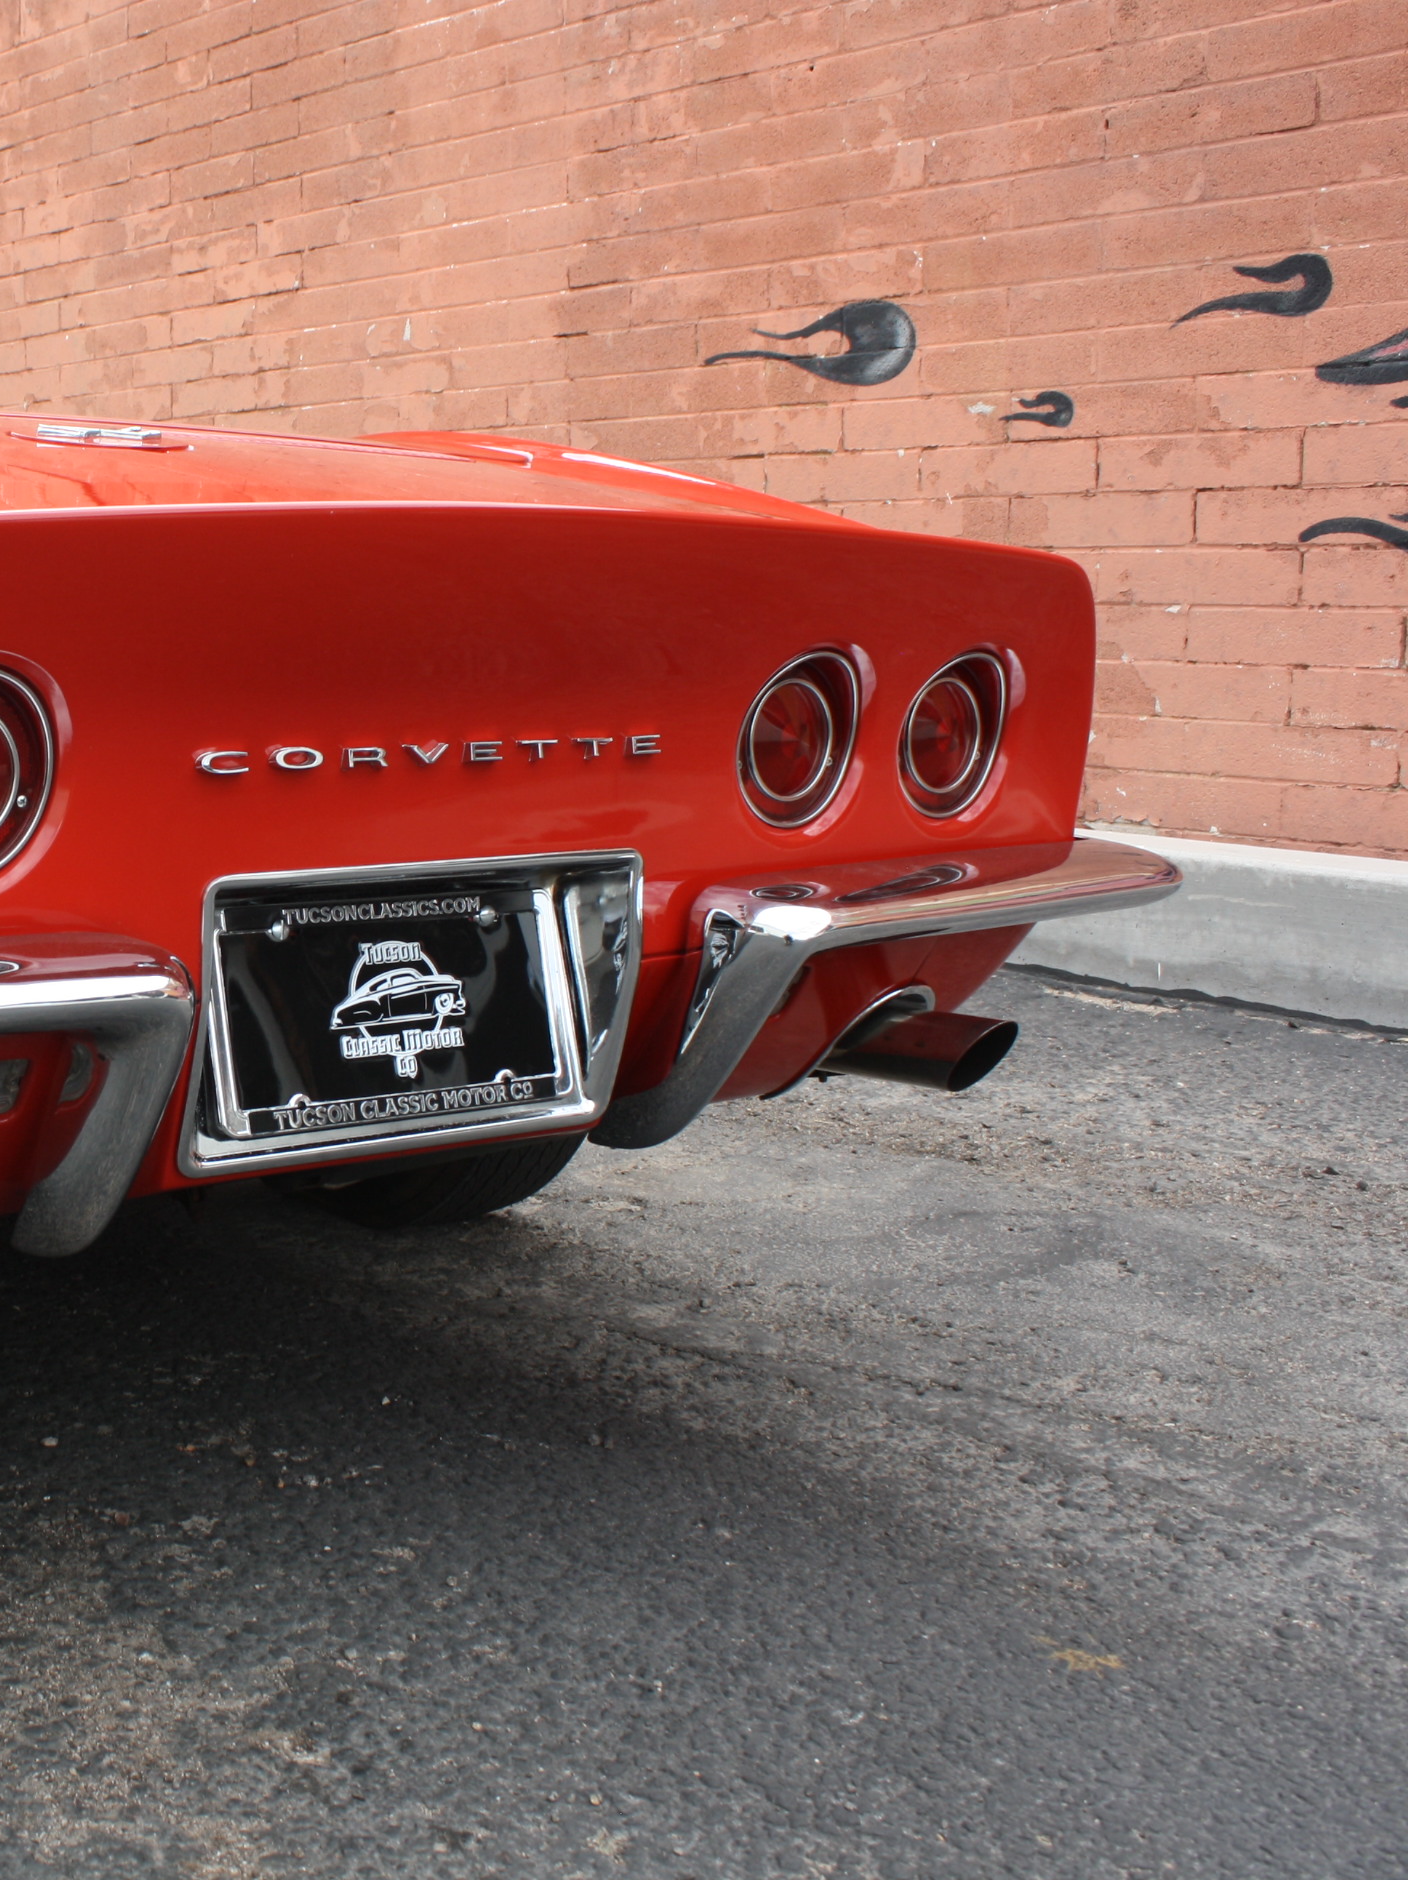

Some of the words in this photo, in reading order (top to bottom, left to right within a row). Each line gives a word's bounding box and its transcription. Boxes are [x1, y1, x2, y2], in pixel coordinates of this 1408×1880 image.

[194, 733, 663, 775] CORVETTE
[281, 896, 481, 926] TUCSONCLASSICS.COM
[359, 942, 423, 966] TUCSON
[340, 1035, 404, 1059] CLASSIC
[402, 1027, 465, 1051] MOTOR
[273, 1102, 357, 1131] TUCSON
[360, 1096, 440, 1121] CLASSIC
[442, 1083, 507, 1110] MOTOR
